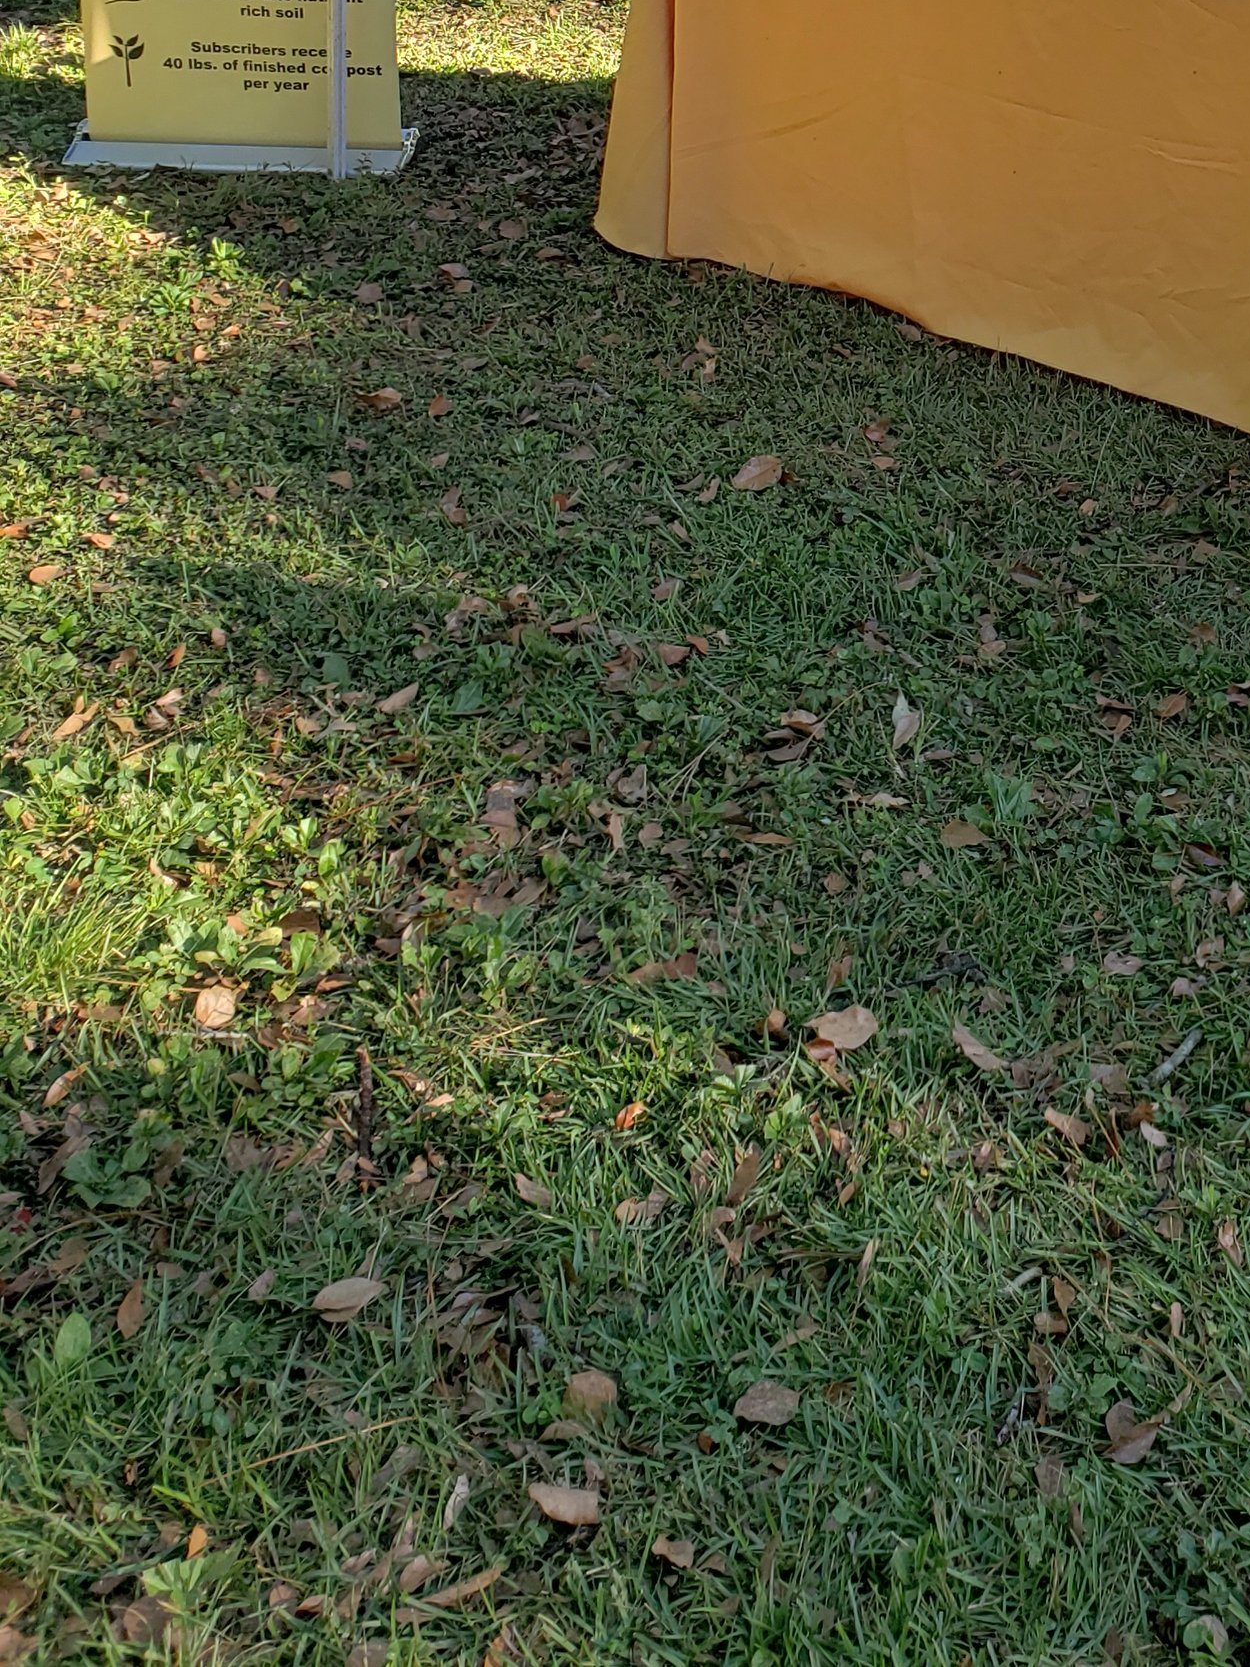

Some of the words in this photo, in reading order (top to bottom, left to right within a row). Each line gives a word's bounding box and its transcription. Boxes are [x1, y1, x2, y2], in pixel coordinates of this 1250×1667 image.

[240, 5, 270, 17] rich
[275, 7, 304, 19] soil
[191, 41, 286, 56] Subscribers
[292, 47, 352, 58] recee
[163, 58, 183, 69] 40
[188, 59, 217, 70] lbs.
[223, 60, 238, 71] of
[243, 60, 306, 74] finished
[311, 64, 382, 77] copost
[243, 80, 269, 91] per
[274, 81, 309, 92] year
